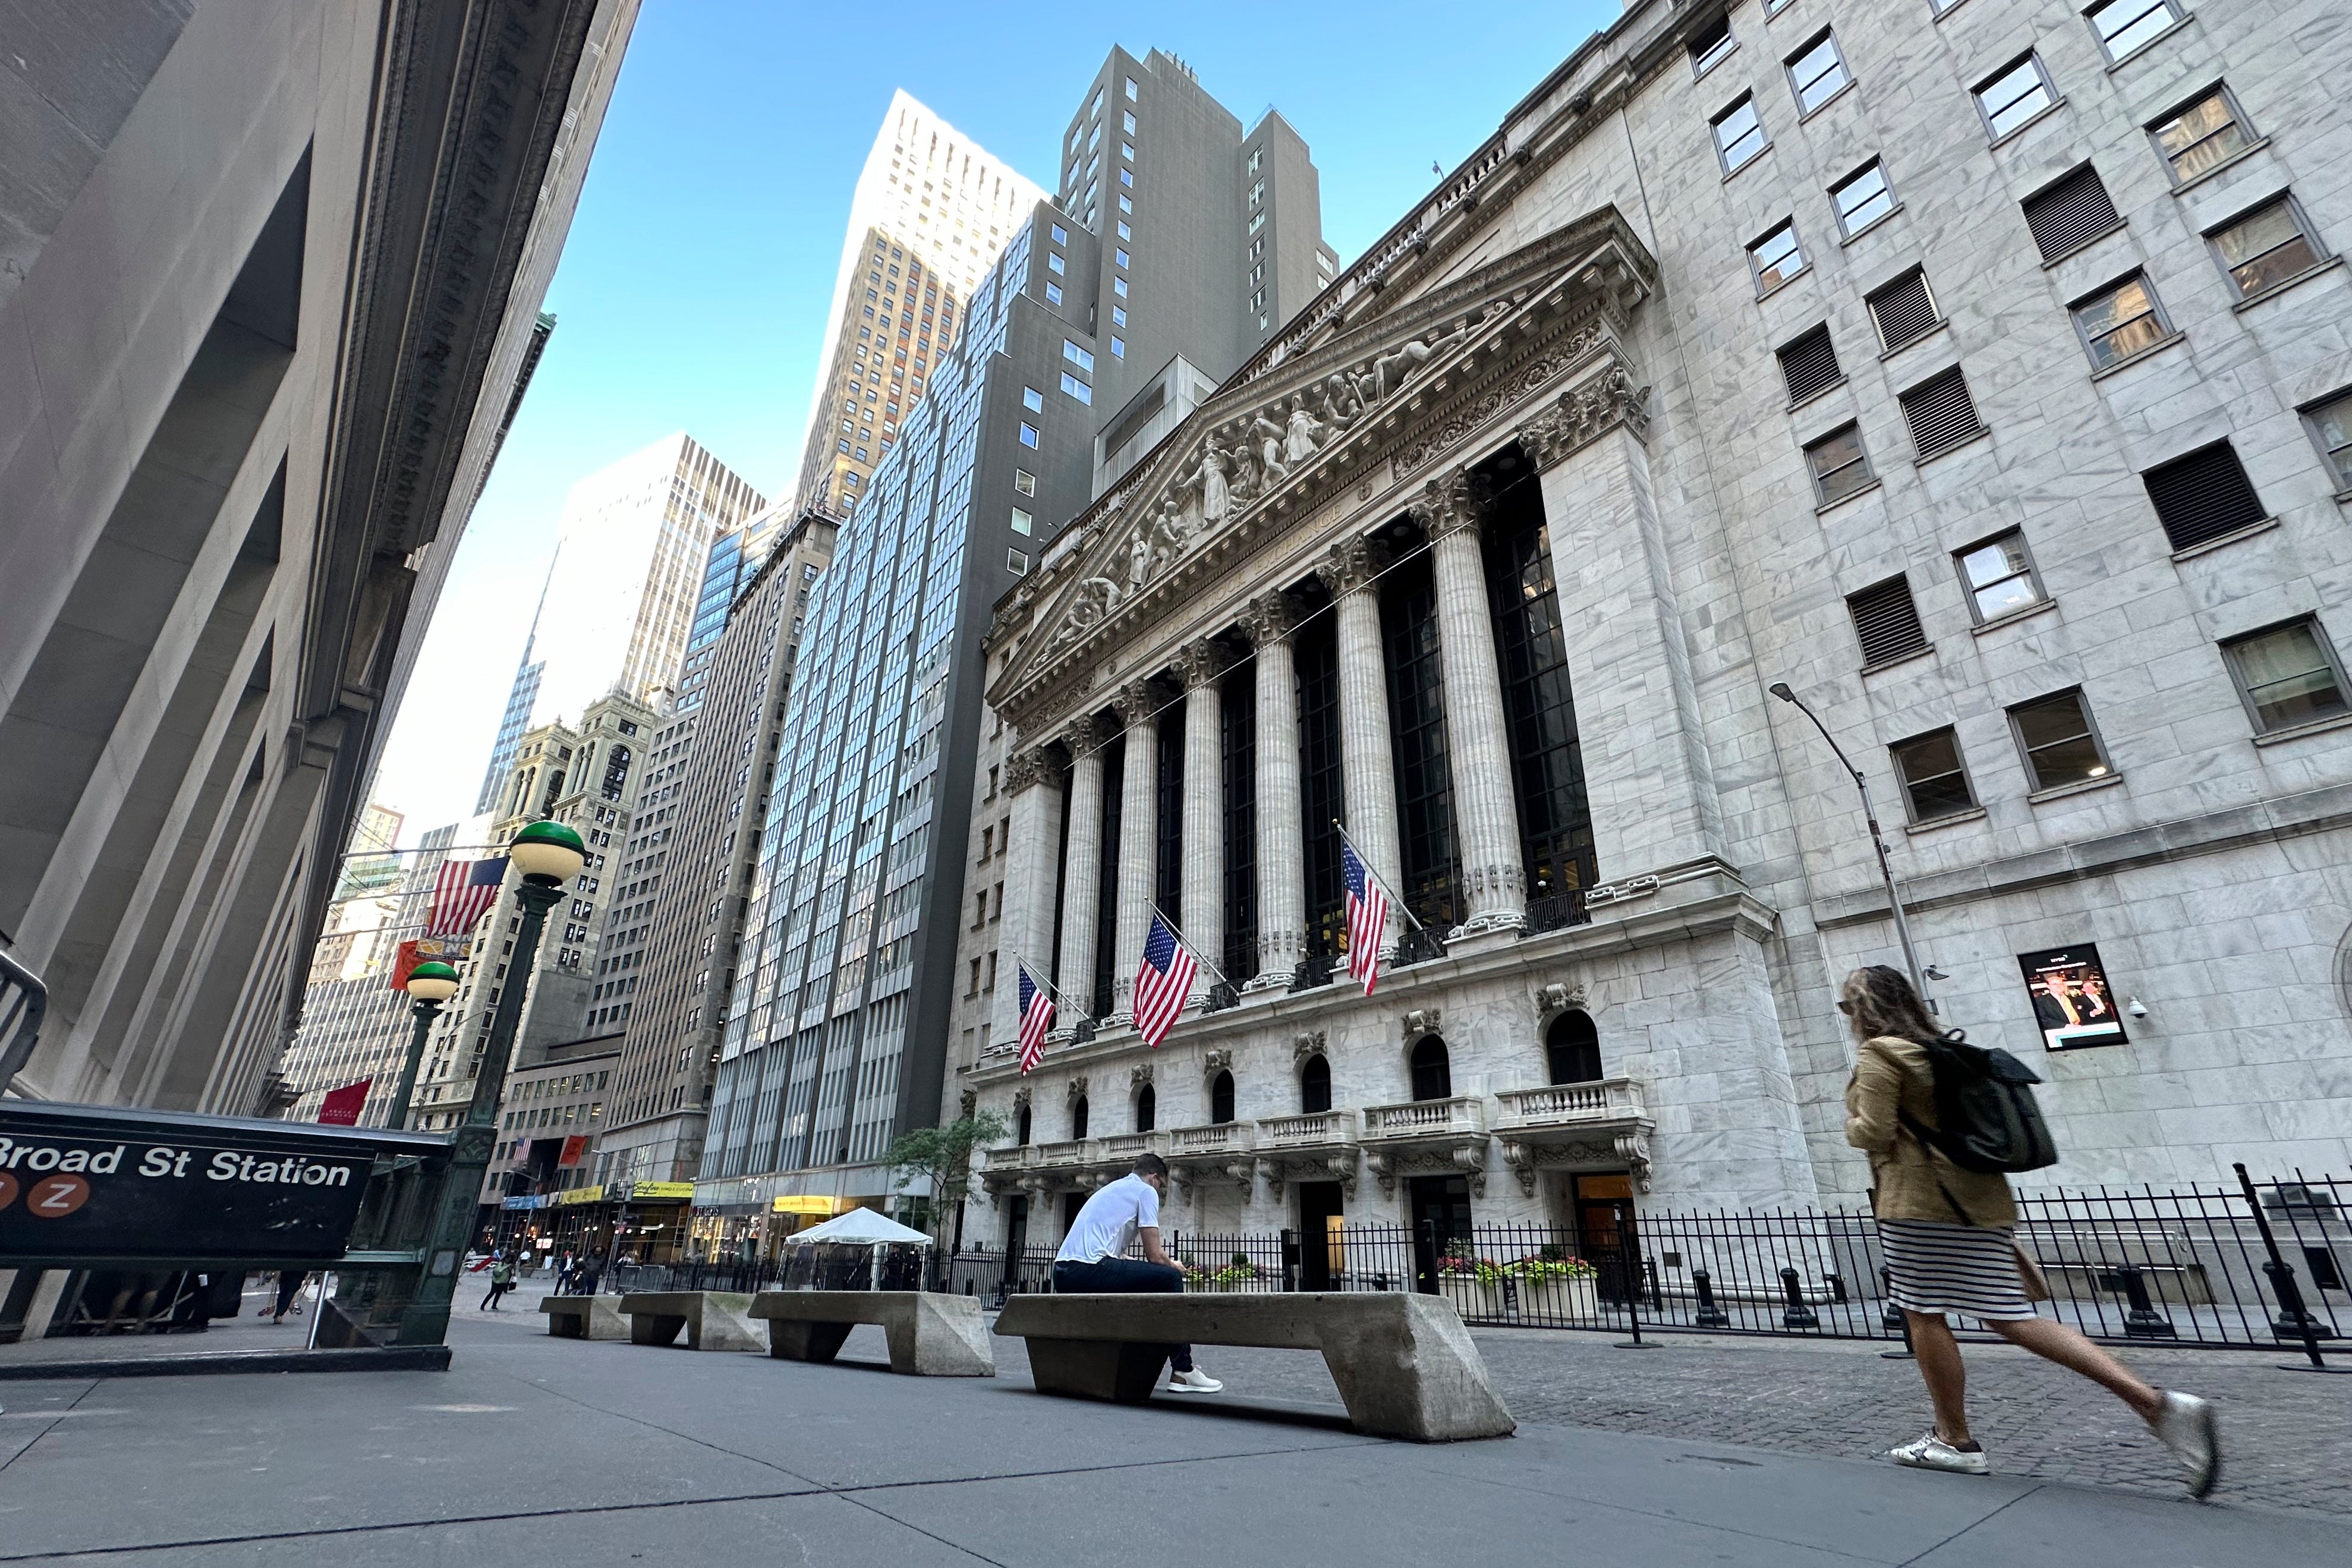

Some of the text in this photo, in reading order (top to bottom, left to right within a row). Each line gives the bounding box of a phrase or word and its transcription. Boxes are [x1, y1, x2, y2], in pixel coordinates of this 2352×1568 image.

[1125, 505, 1343, 664] NEW YORK STOCK EXCHANGE
[138, 1147, 192, 1177] St
[206, 1152, 351, 1186] Station
[40, 1183, 77, 1208] Z
